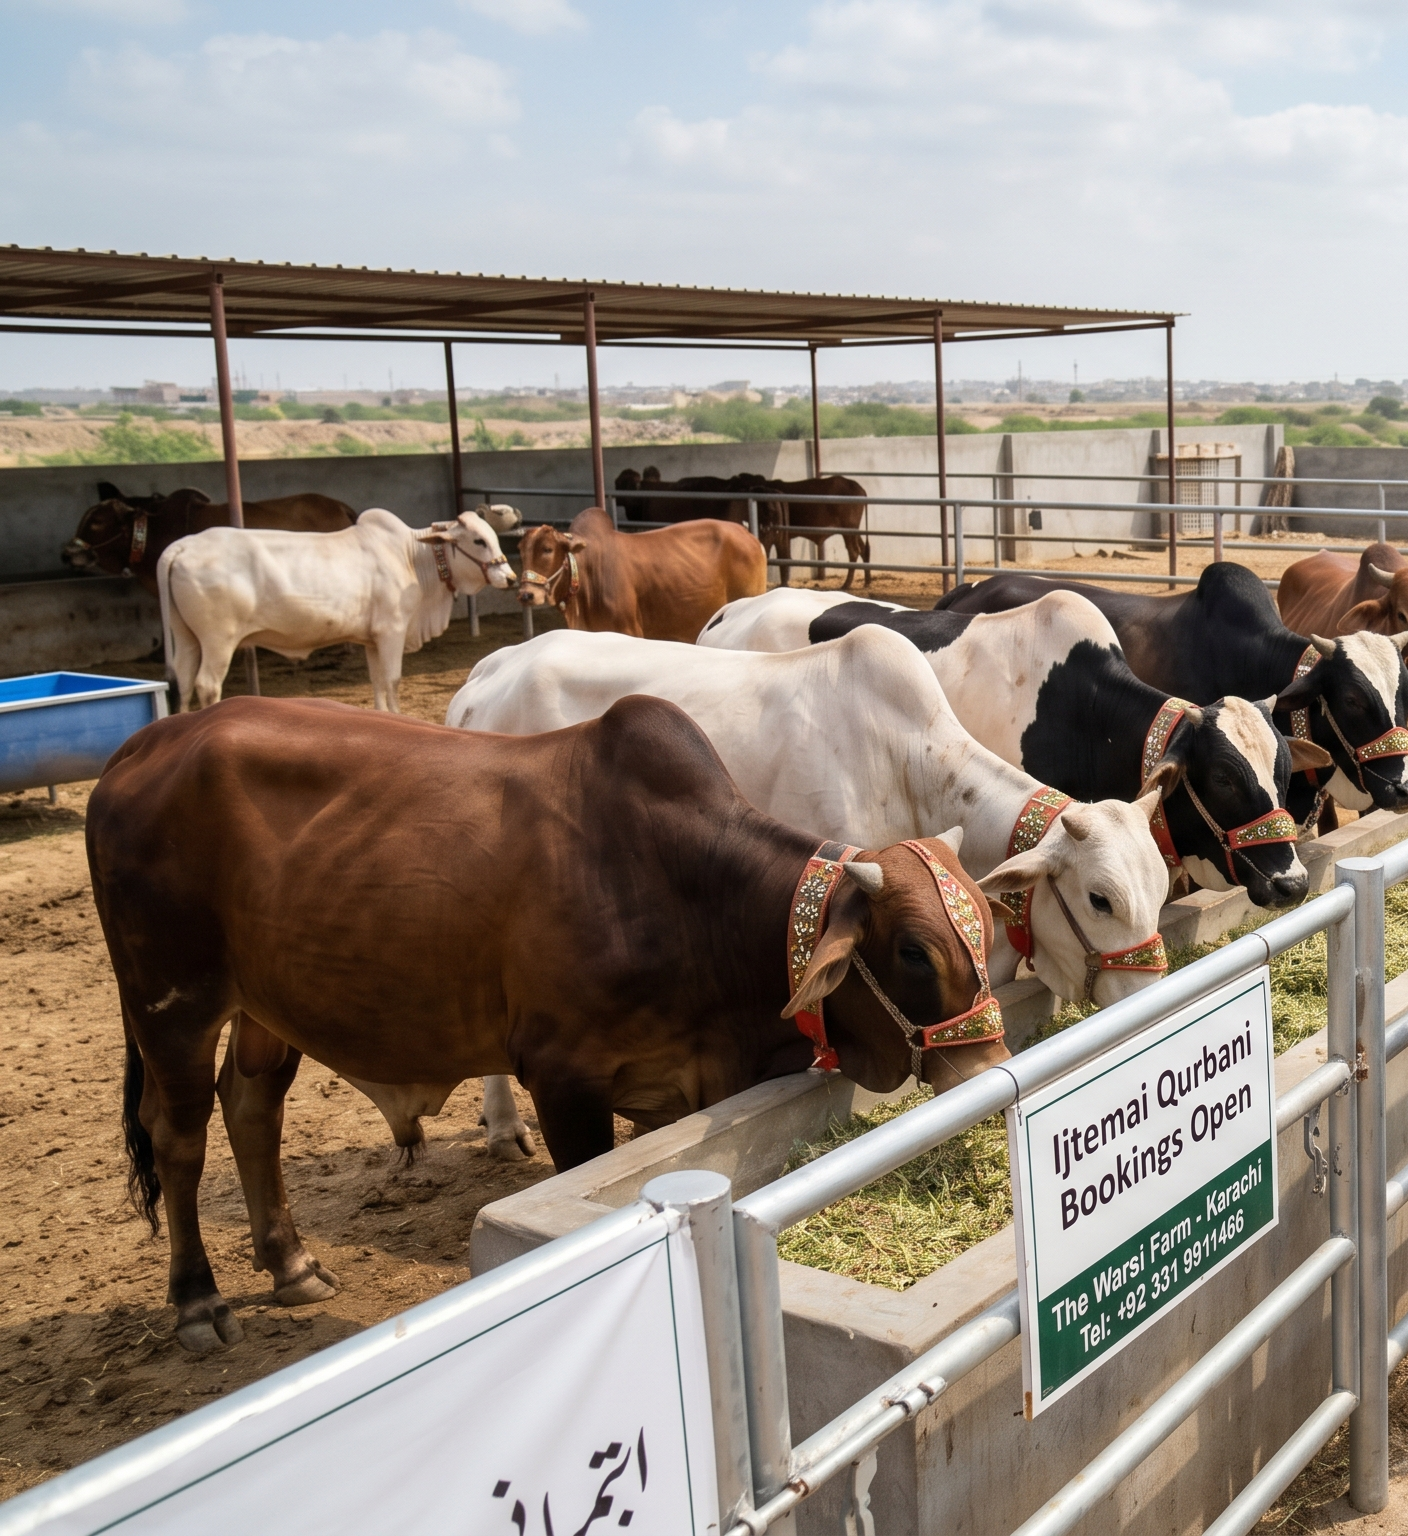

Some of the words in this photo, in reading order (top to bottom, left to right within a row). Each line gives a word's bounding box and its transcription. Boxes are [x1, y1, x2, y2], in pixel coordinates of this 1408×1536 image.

[1052, 1082, 1148, 1181] Ijtemai
[1156, 1020, 1252, 1109] Qurbani
[1060, 1128, 1184, 1231] Bookings
[1190, 1083, 1252, 1143] Open
[1051, 1291, 1089, 1333] The
[1092, 1243, 1145, 1303] Warsi
[1150, 1217, 1191, 1264] Farm
[1206, 1157, 1262, 1223] Karachi
[1079, 1312, 1111, 1353] Tel:
[1117, 1283, 1147, 1321] +92
[1151, 1257, 1178, 1300] 331
[1183, 1208, 1244, 1274] 9911466
